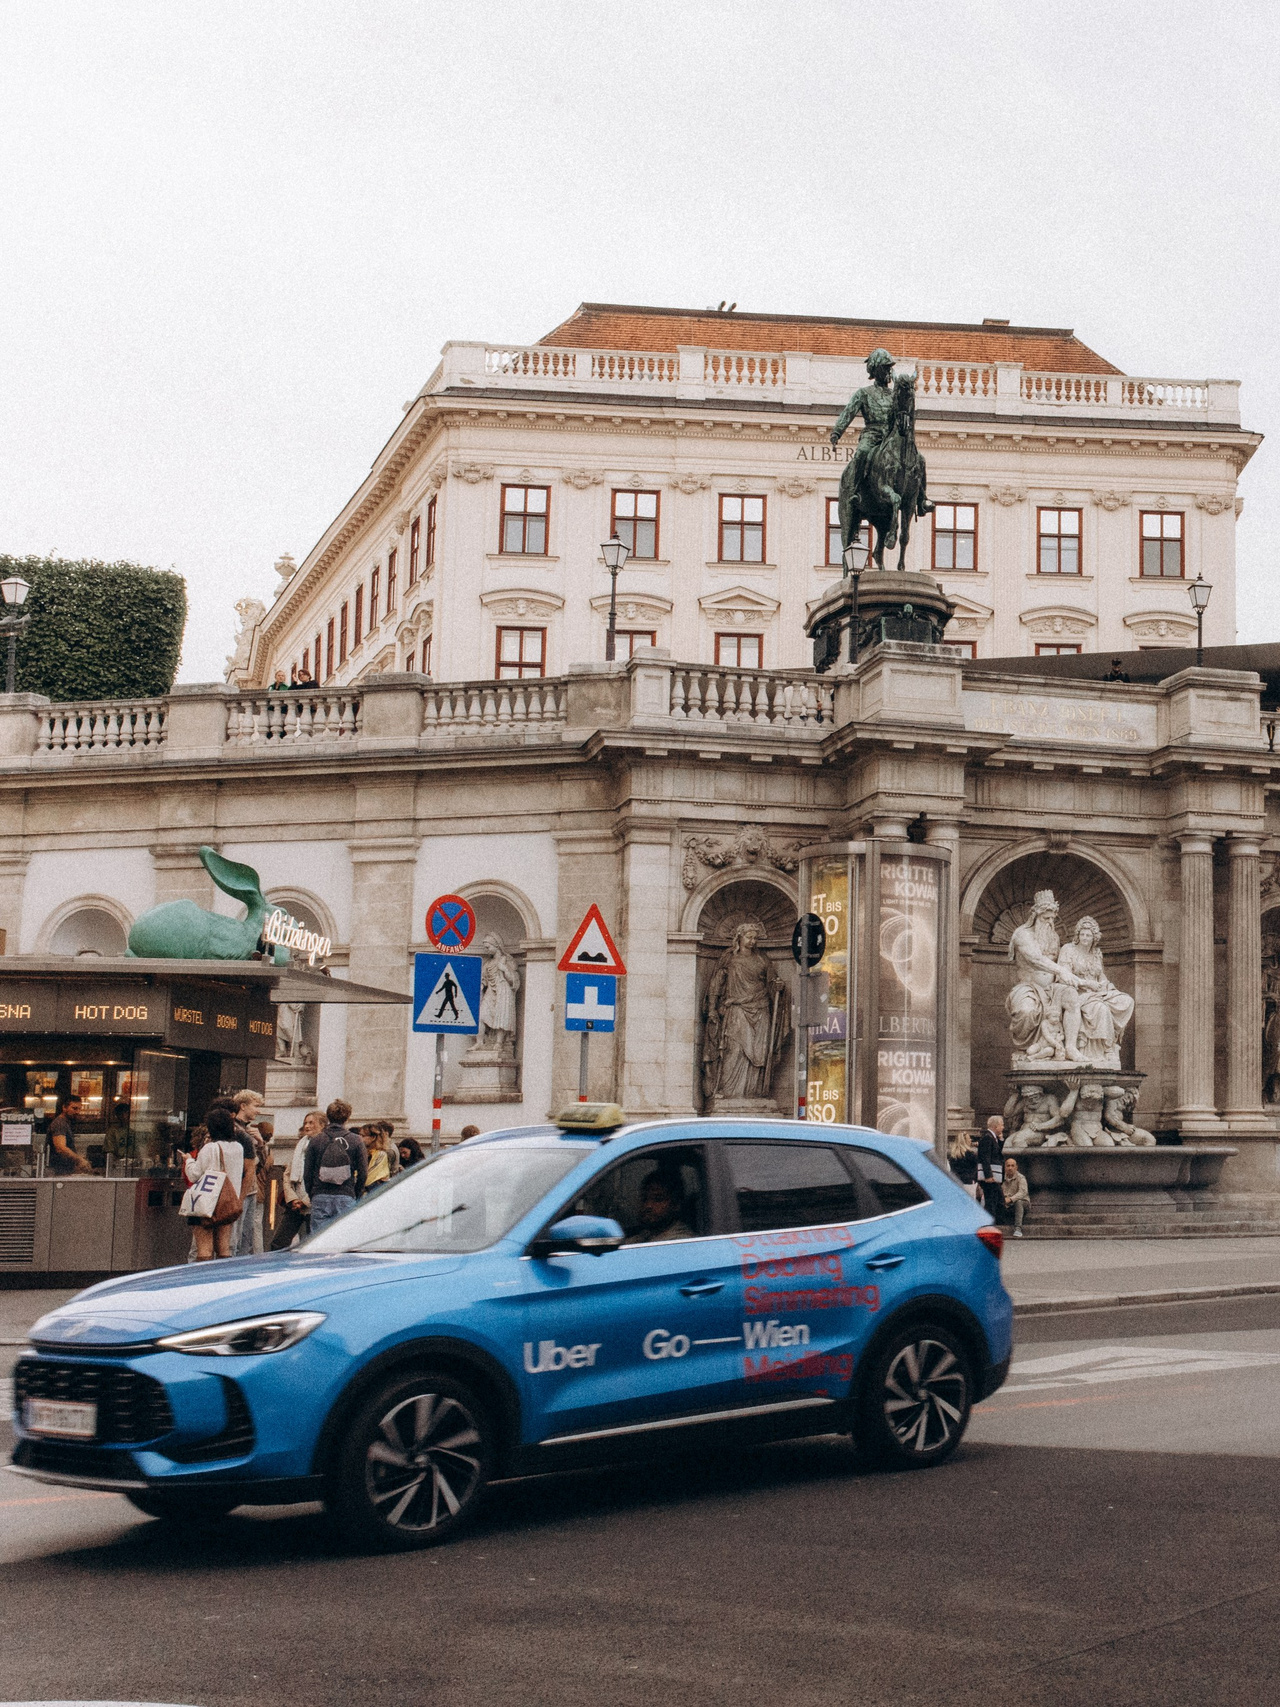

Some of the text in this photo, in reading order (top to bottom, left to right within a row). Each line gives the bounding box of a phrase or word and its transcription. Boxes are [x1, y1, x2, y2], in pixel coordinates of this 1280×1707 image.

[826, 901, 842, 912] BIS
[267, 909, 332, 966] Bitzinger
[436, 942, 464, 954] ANFANG
[75, 1005, 110, 1019] HOT
[113, 1006, 148, 1020] DOG
[249, 1020, 261, 1034] HOT
[262, 1022, 273, 1036] DOG
[823, 1090, 839, 1100] BIS
[741, 1249, 843, 1281] Döbling
[744, 1281, 881, 1315] Simmering
[642, 1319, 810, 1360] Go Wien
[523, 1340, 602, 1374] Uber
